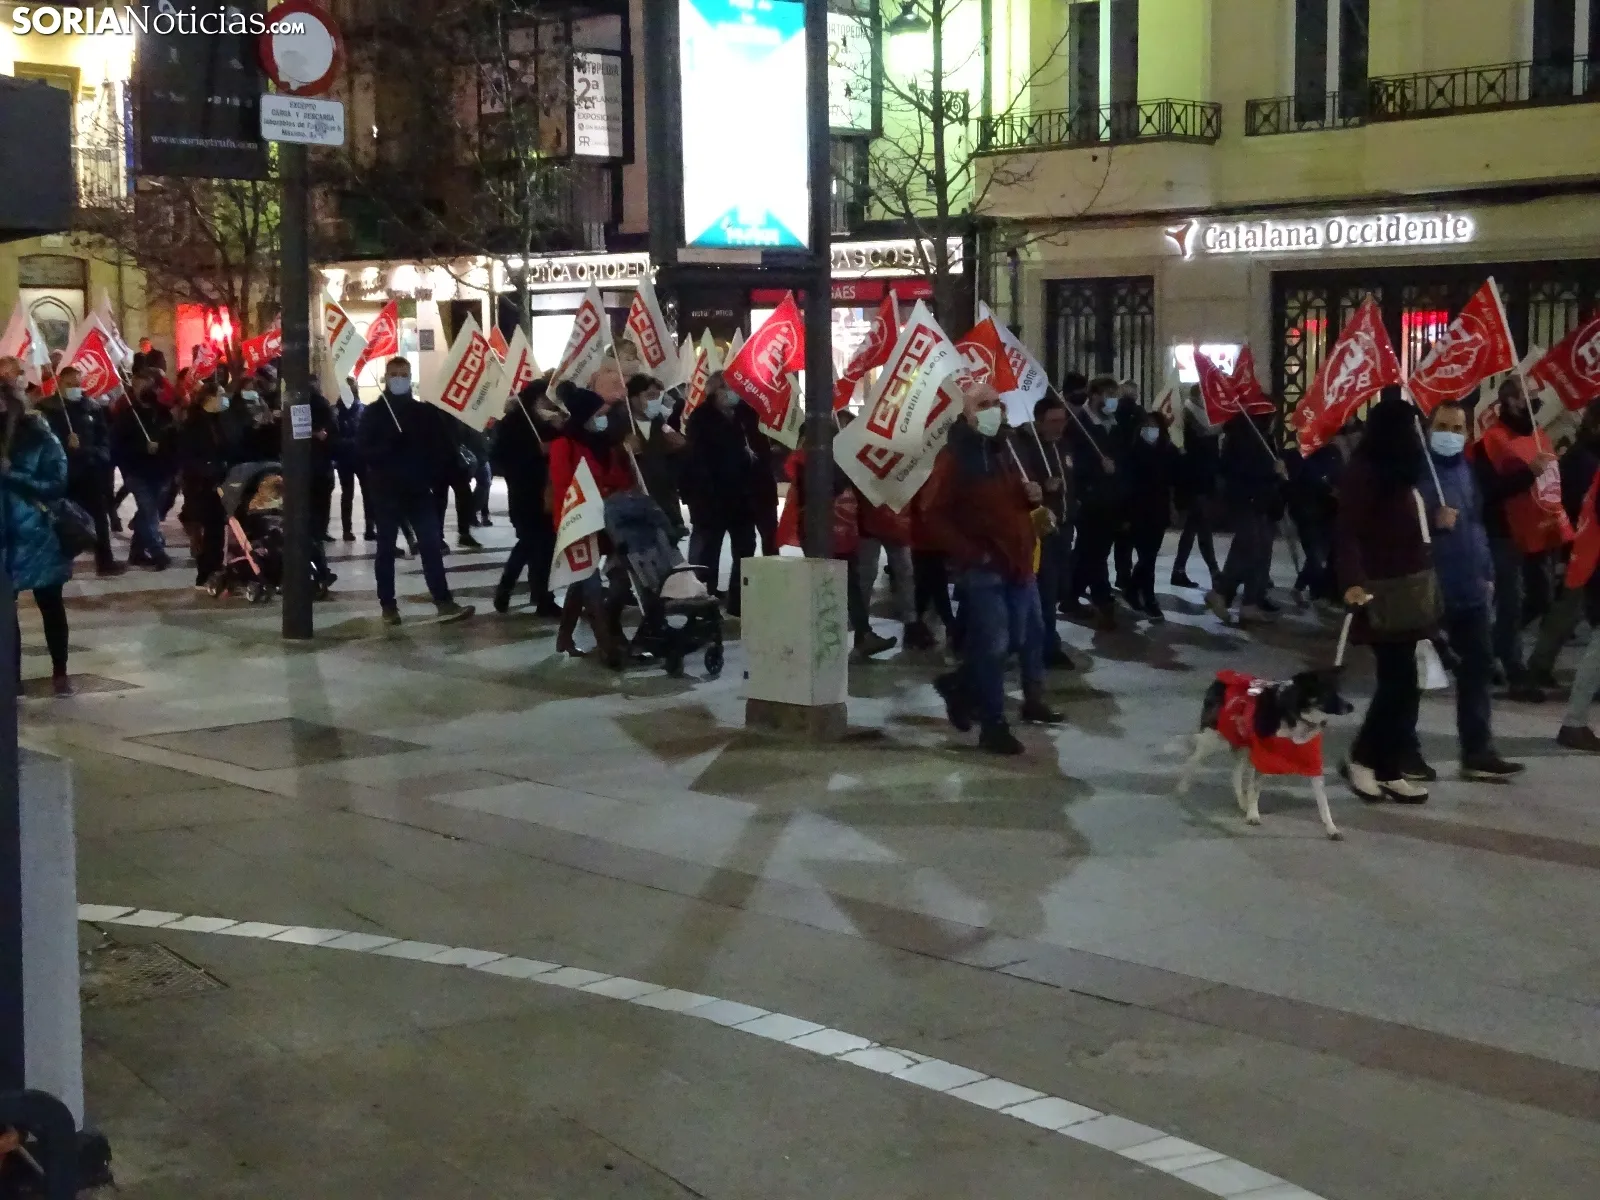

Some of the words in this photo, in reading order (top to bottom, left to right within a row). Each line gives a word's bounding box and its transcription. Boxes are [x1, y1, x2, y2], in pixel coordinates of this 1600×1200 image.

[1201, 217, 1319, 251] Catalana
[1325, 211, 1470, 245] Occidente
[527, 263, 572, 284] PTICA
